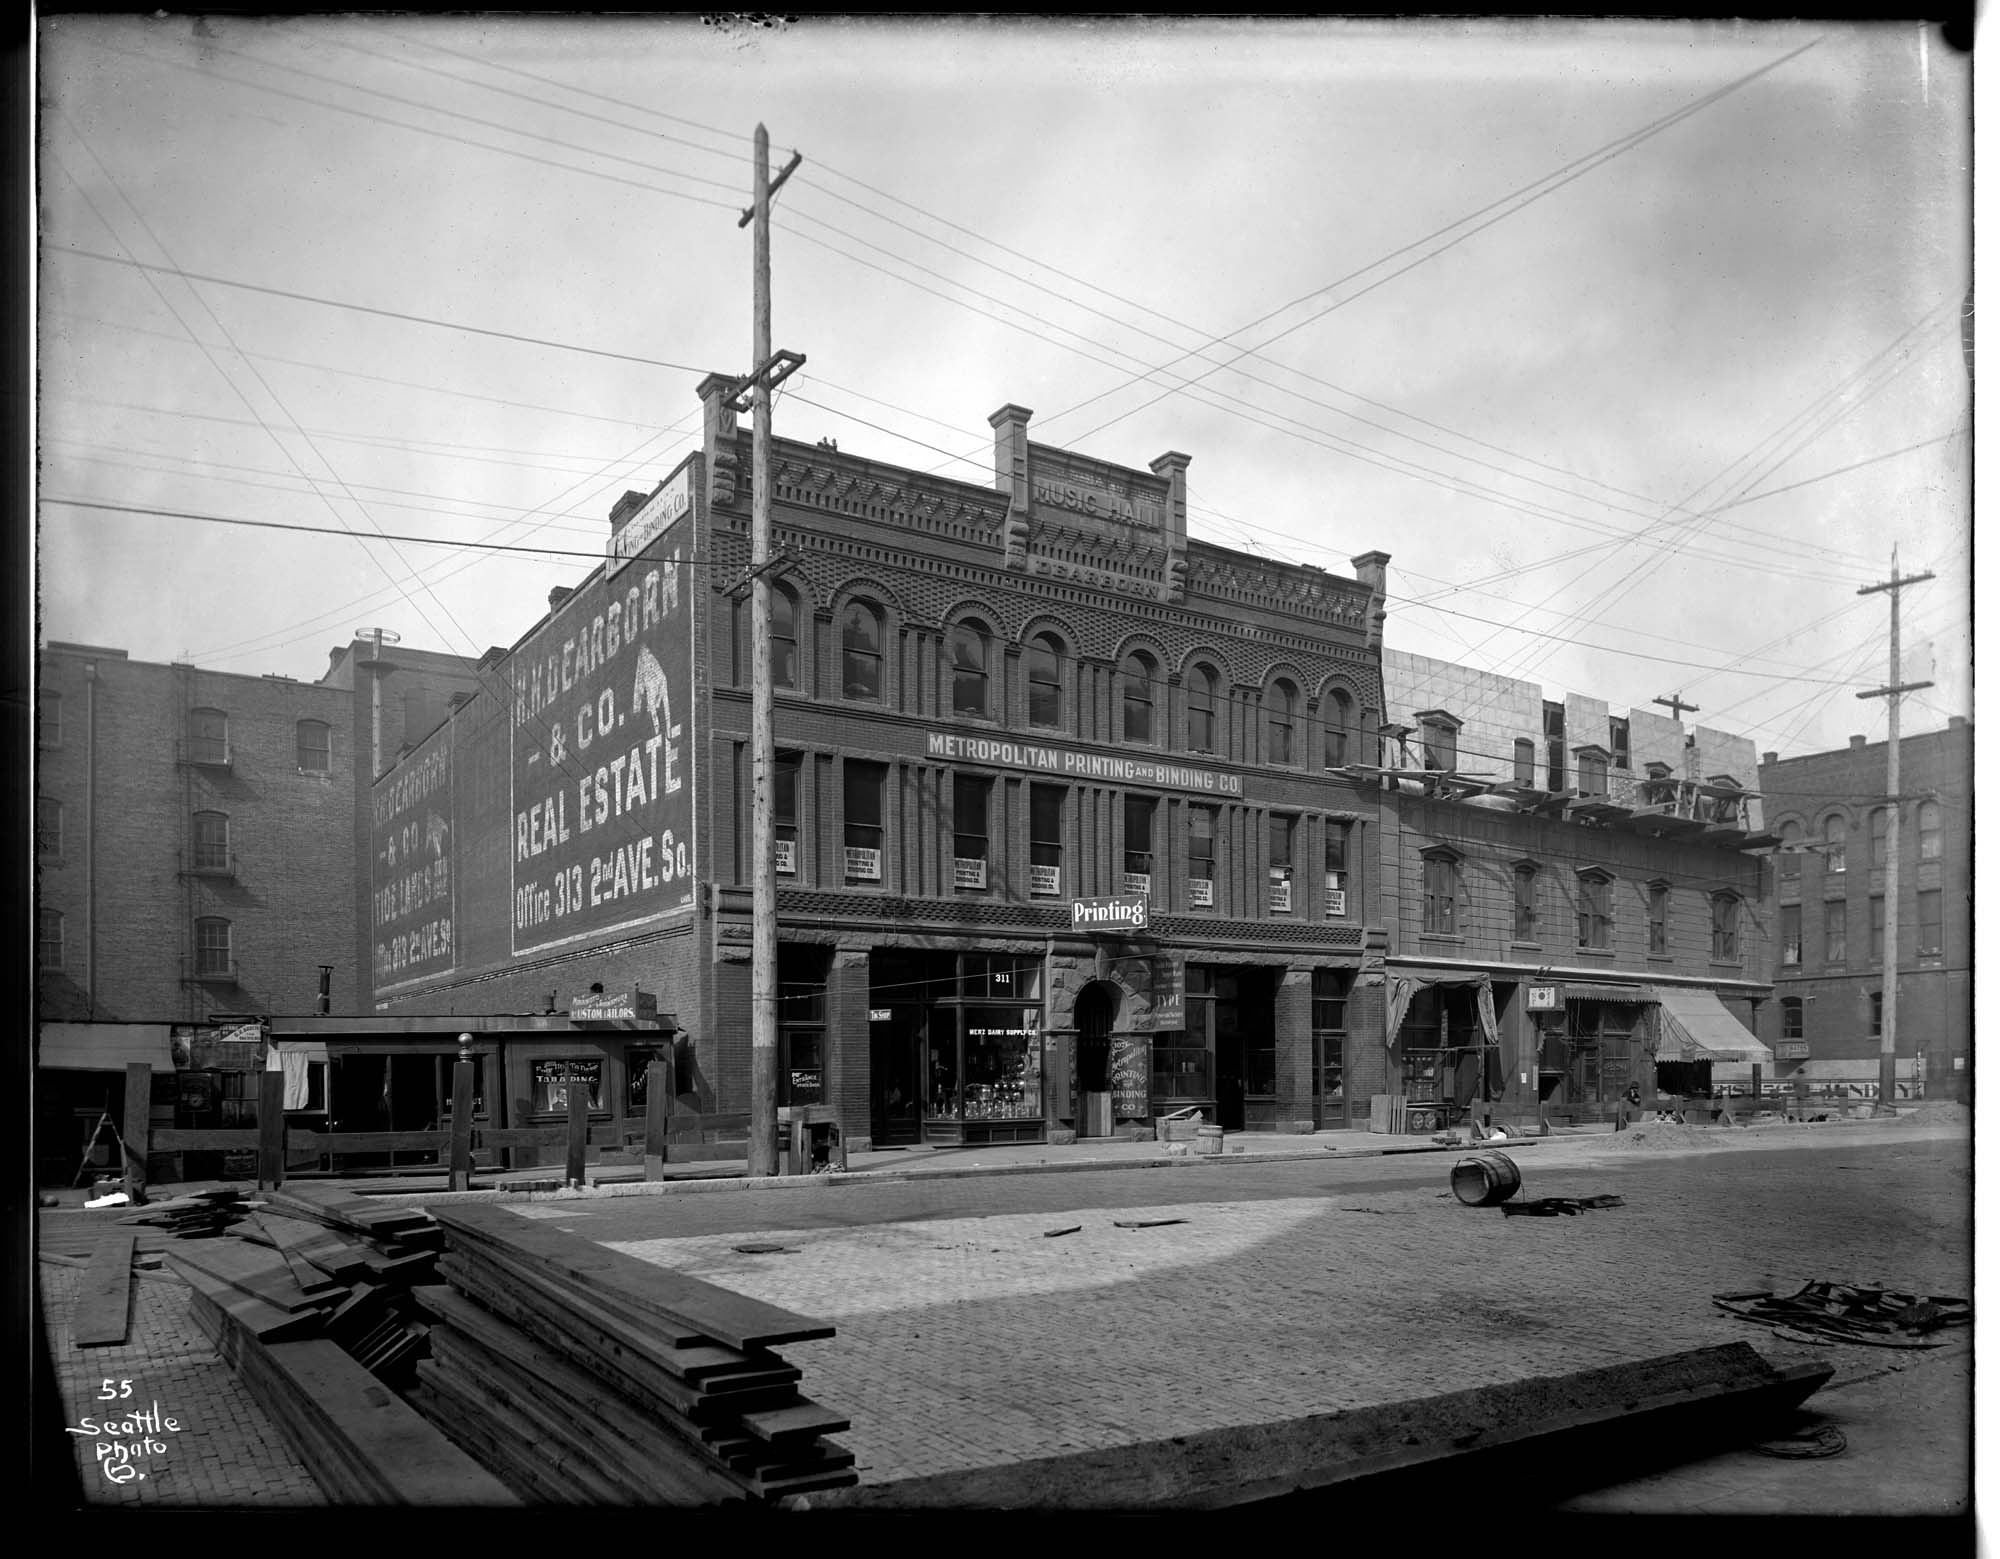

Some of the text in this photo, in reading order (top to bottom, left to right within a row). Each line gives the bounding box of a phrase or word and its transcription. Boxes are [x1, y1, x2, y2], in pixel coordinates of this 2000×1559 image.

[1036, 484, 1161, 531] MUSIC HALL
[1035, 560, 1160, 600] DEARBORN
[550, 688, 625, 767] & CO.
[929, 734, 1241, 793] METROPOLITAN PRINTING AND BINDING CO.
[517, 724, 682, 862] REAL ESTATE
[555, 865, 583, 917] 313
[995, 974, 1010, 983] 311
[1157, 993, 1181, 1007] TYPE
[1112, 1070, 1147, 1084] PRINTING
[1112, 1089, 1147, 1099] BINDING
